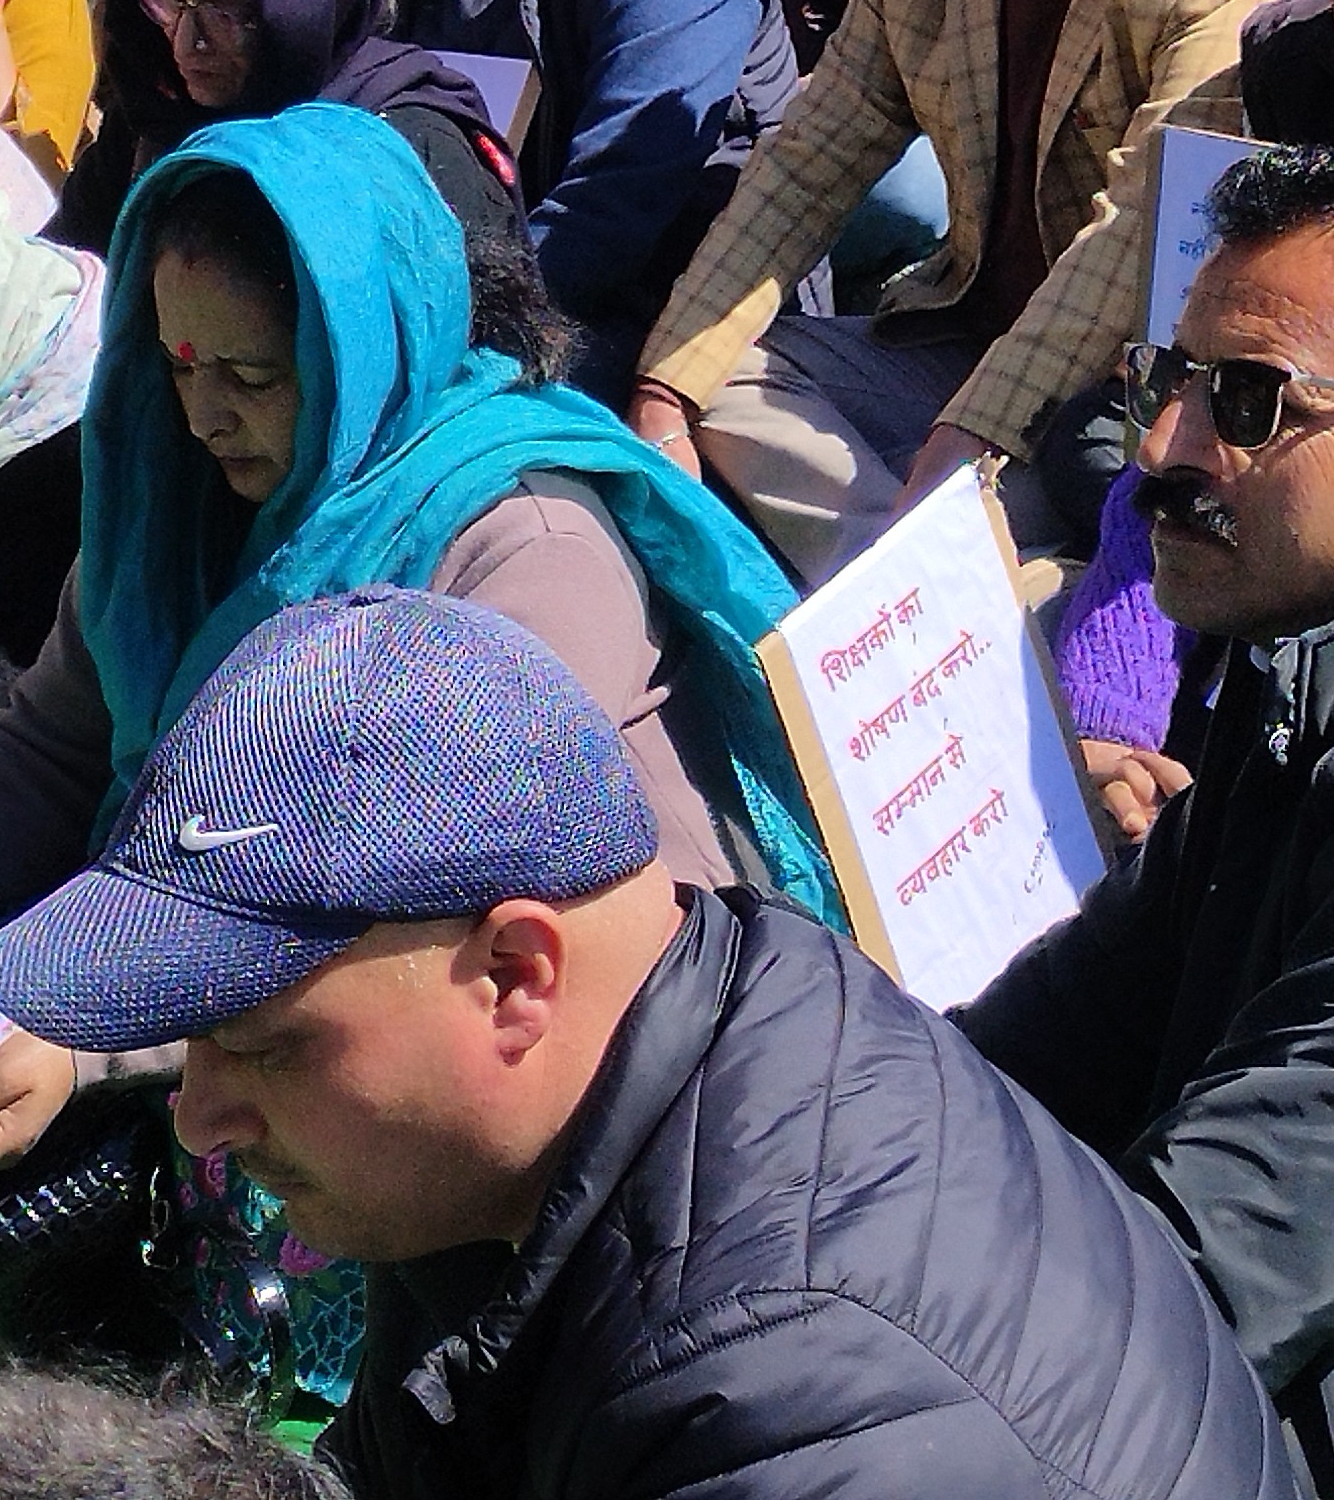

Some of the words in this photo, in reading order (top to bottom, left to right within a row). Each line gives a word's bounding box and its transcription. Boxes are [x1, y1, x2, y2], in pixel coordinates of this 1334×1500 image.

[819, 602, 897, 692] शिक्षकों
[892, 586, 926, 628] का
[848, 694, 909, 763] शोषण
[907, 669, 942, 710] बंद
[871, 752, 947, 837] सम्मान
[943, 733, 969, 771] से
[894, 825, 974, 907] व्यवहार
[968, 789, 1011, 840] करो
